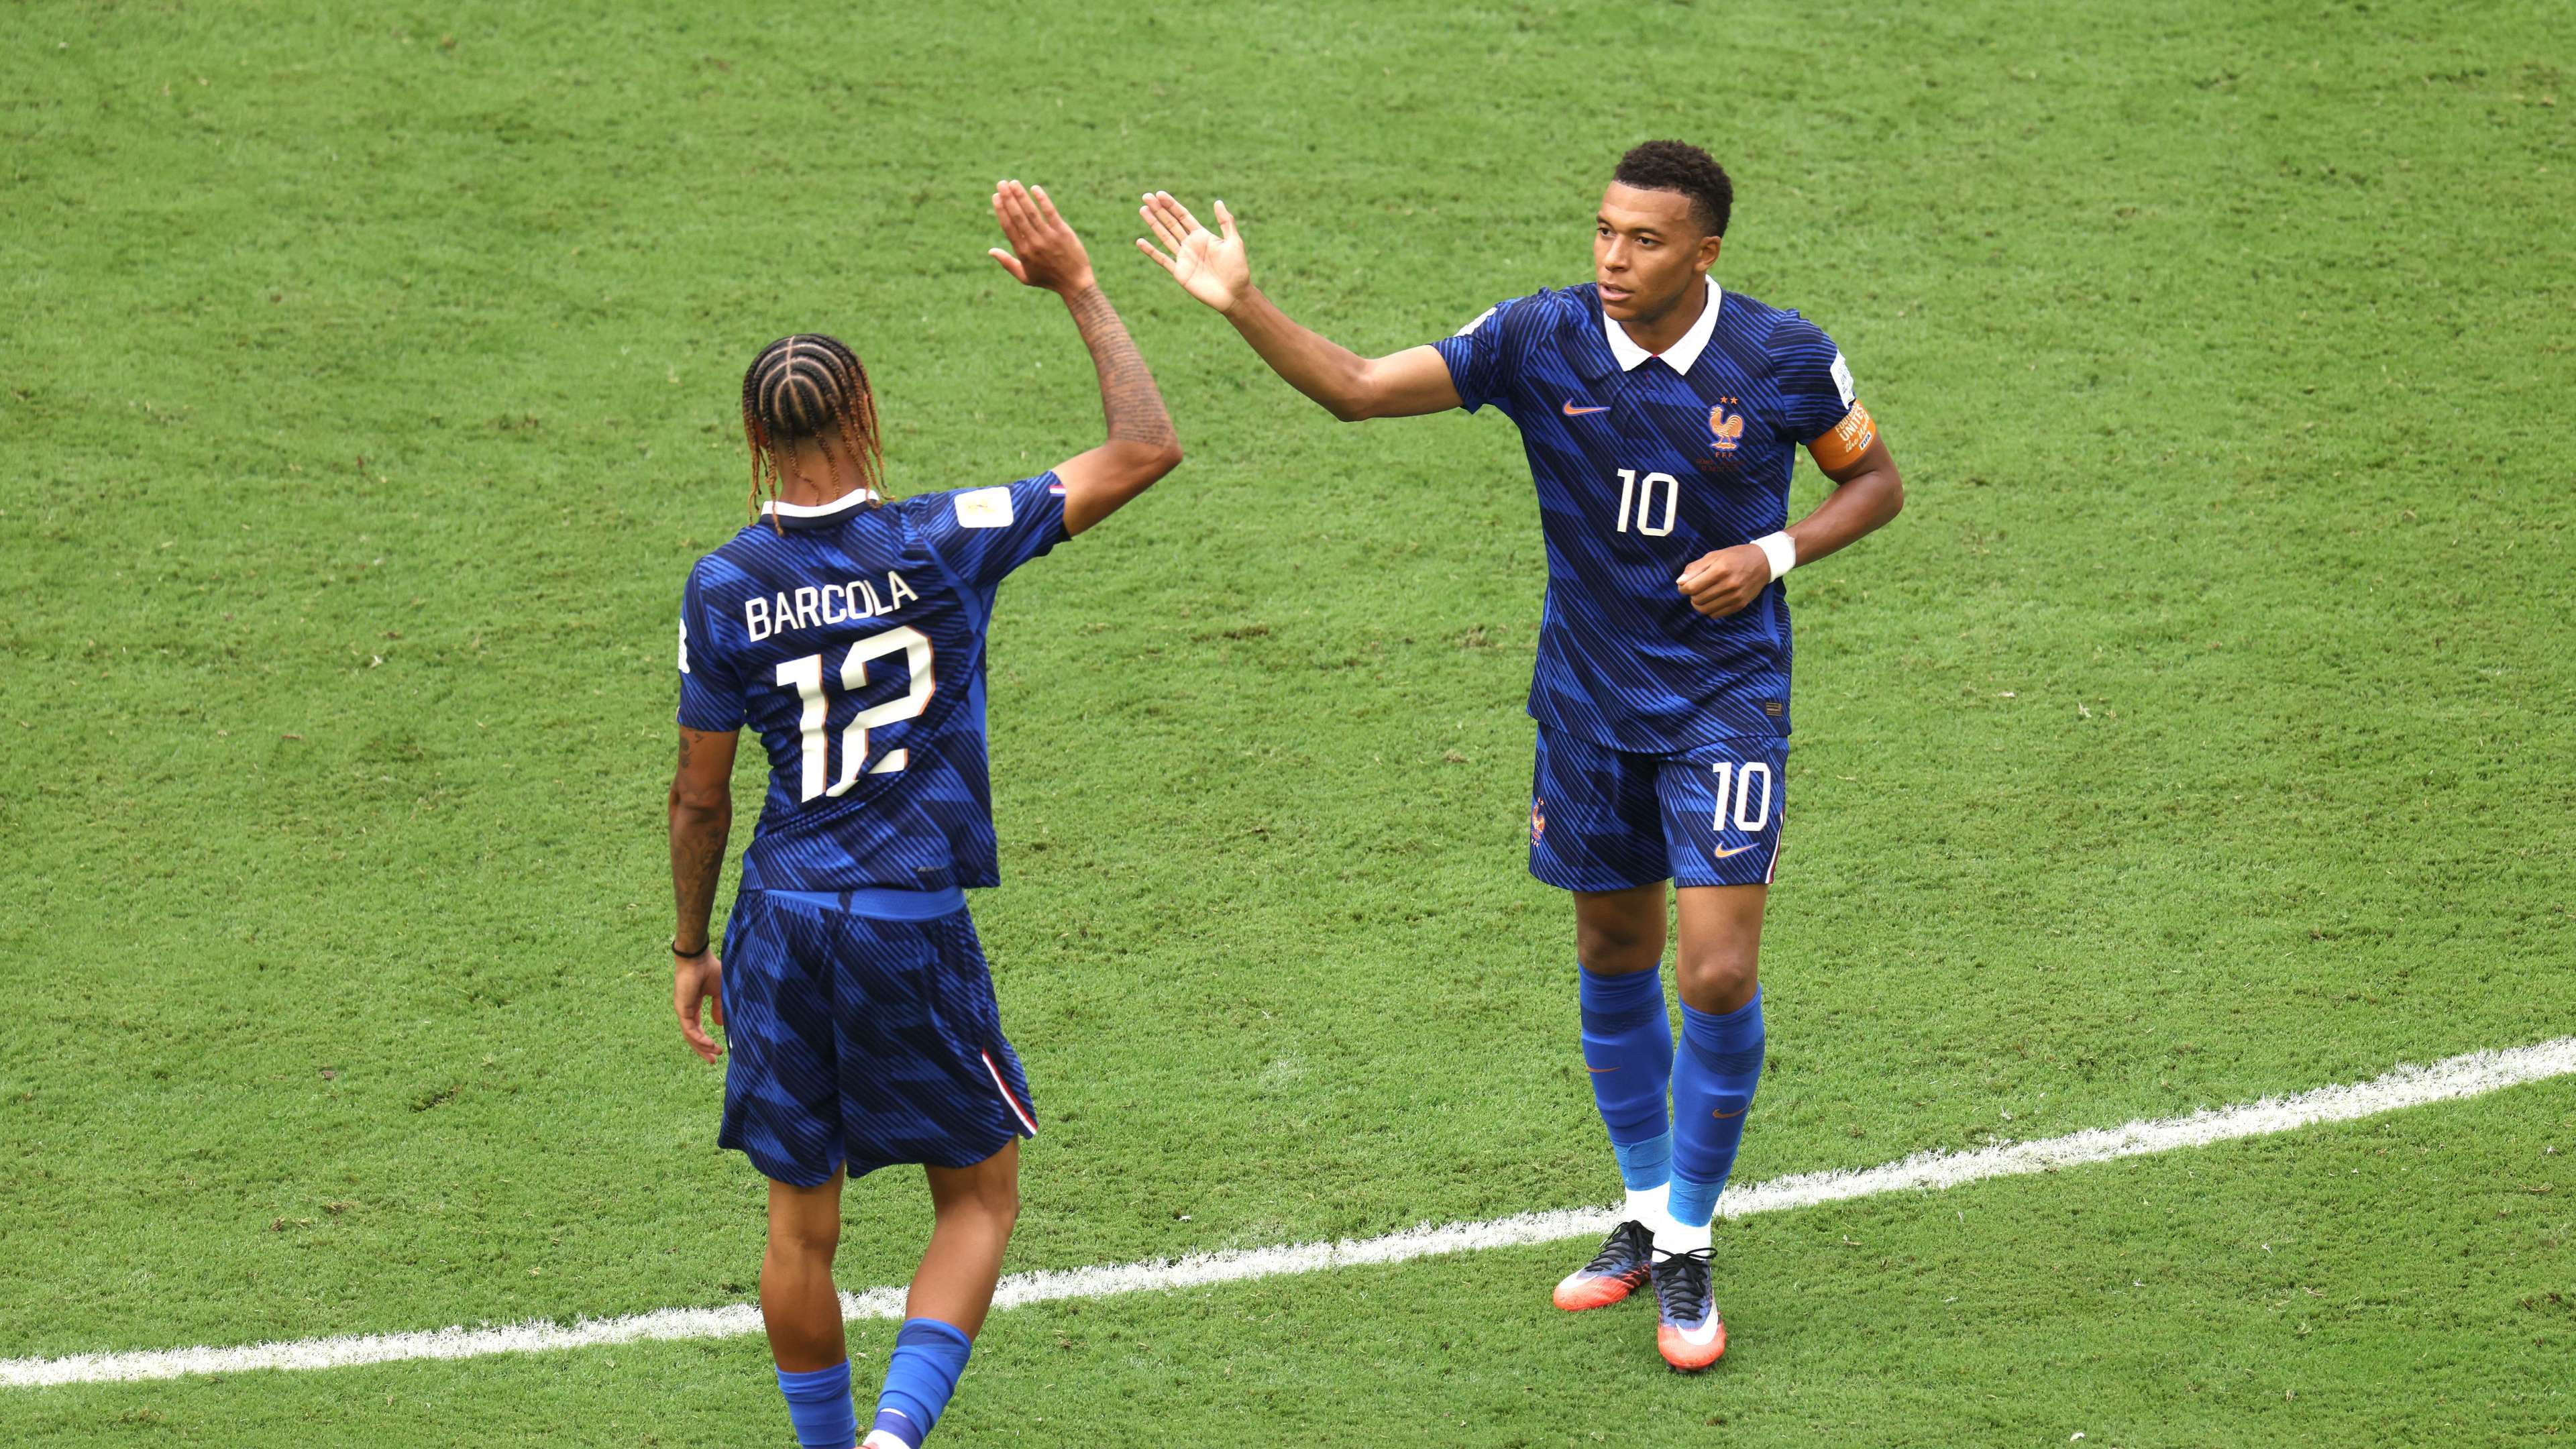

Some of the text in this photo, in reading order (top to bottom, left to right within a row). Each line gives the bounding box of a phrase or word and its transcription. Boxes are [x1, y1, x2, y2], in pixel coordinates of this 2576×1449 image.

[1839, 404, 1864, 441] UNITES
[1846, 439, 1859, 453] the
[1861, 433, 1871, 448] FIFA
[1617, 468, 1678, 537] 10
[745, 570, 919, 643] BARCOLA
[775, 625, 936, 803] 12
[1713, 761, 1771, 831] 10
